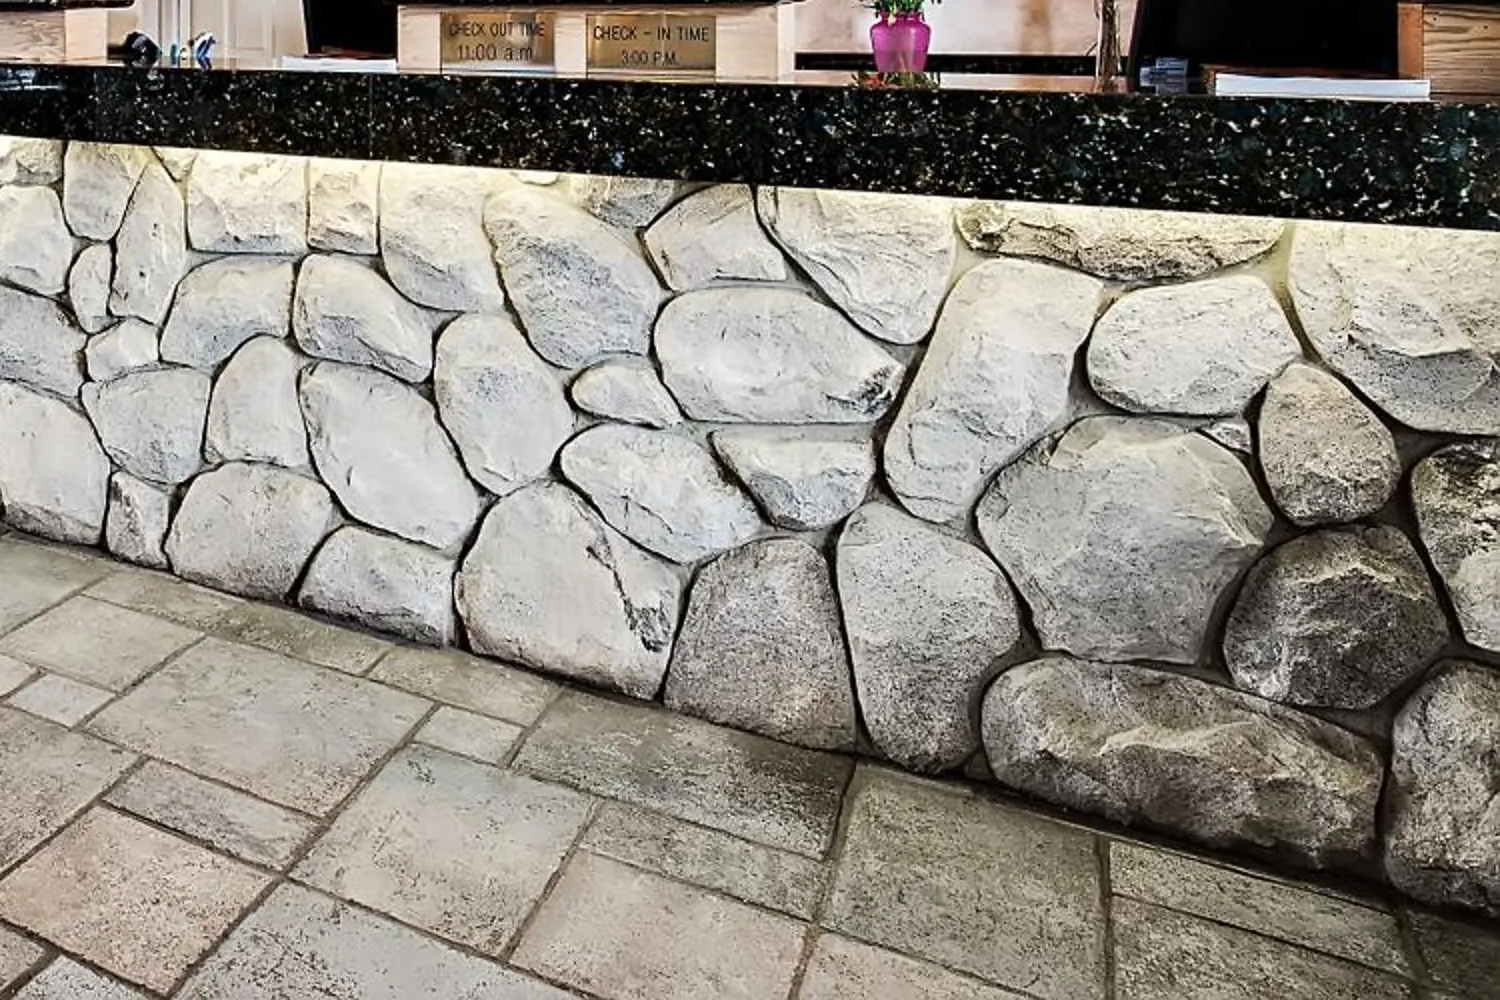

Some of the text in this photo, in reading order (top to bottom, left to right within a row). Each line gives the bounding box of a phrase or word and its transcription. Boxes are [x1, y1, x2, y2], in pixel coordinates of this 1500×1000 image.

[449, 21, 546, 37] CHECK OUT TIME
[593, 25, 637, 41] CHECK
[657, 25, 671, 41] IN
[676, 26, 709, 42] TIME
[458, 43, 497, 62] 11:00
[621, 49, 649, 66] 3:00
